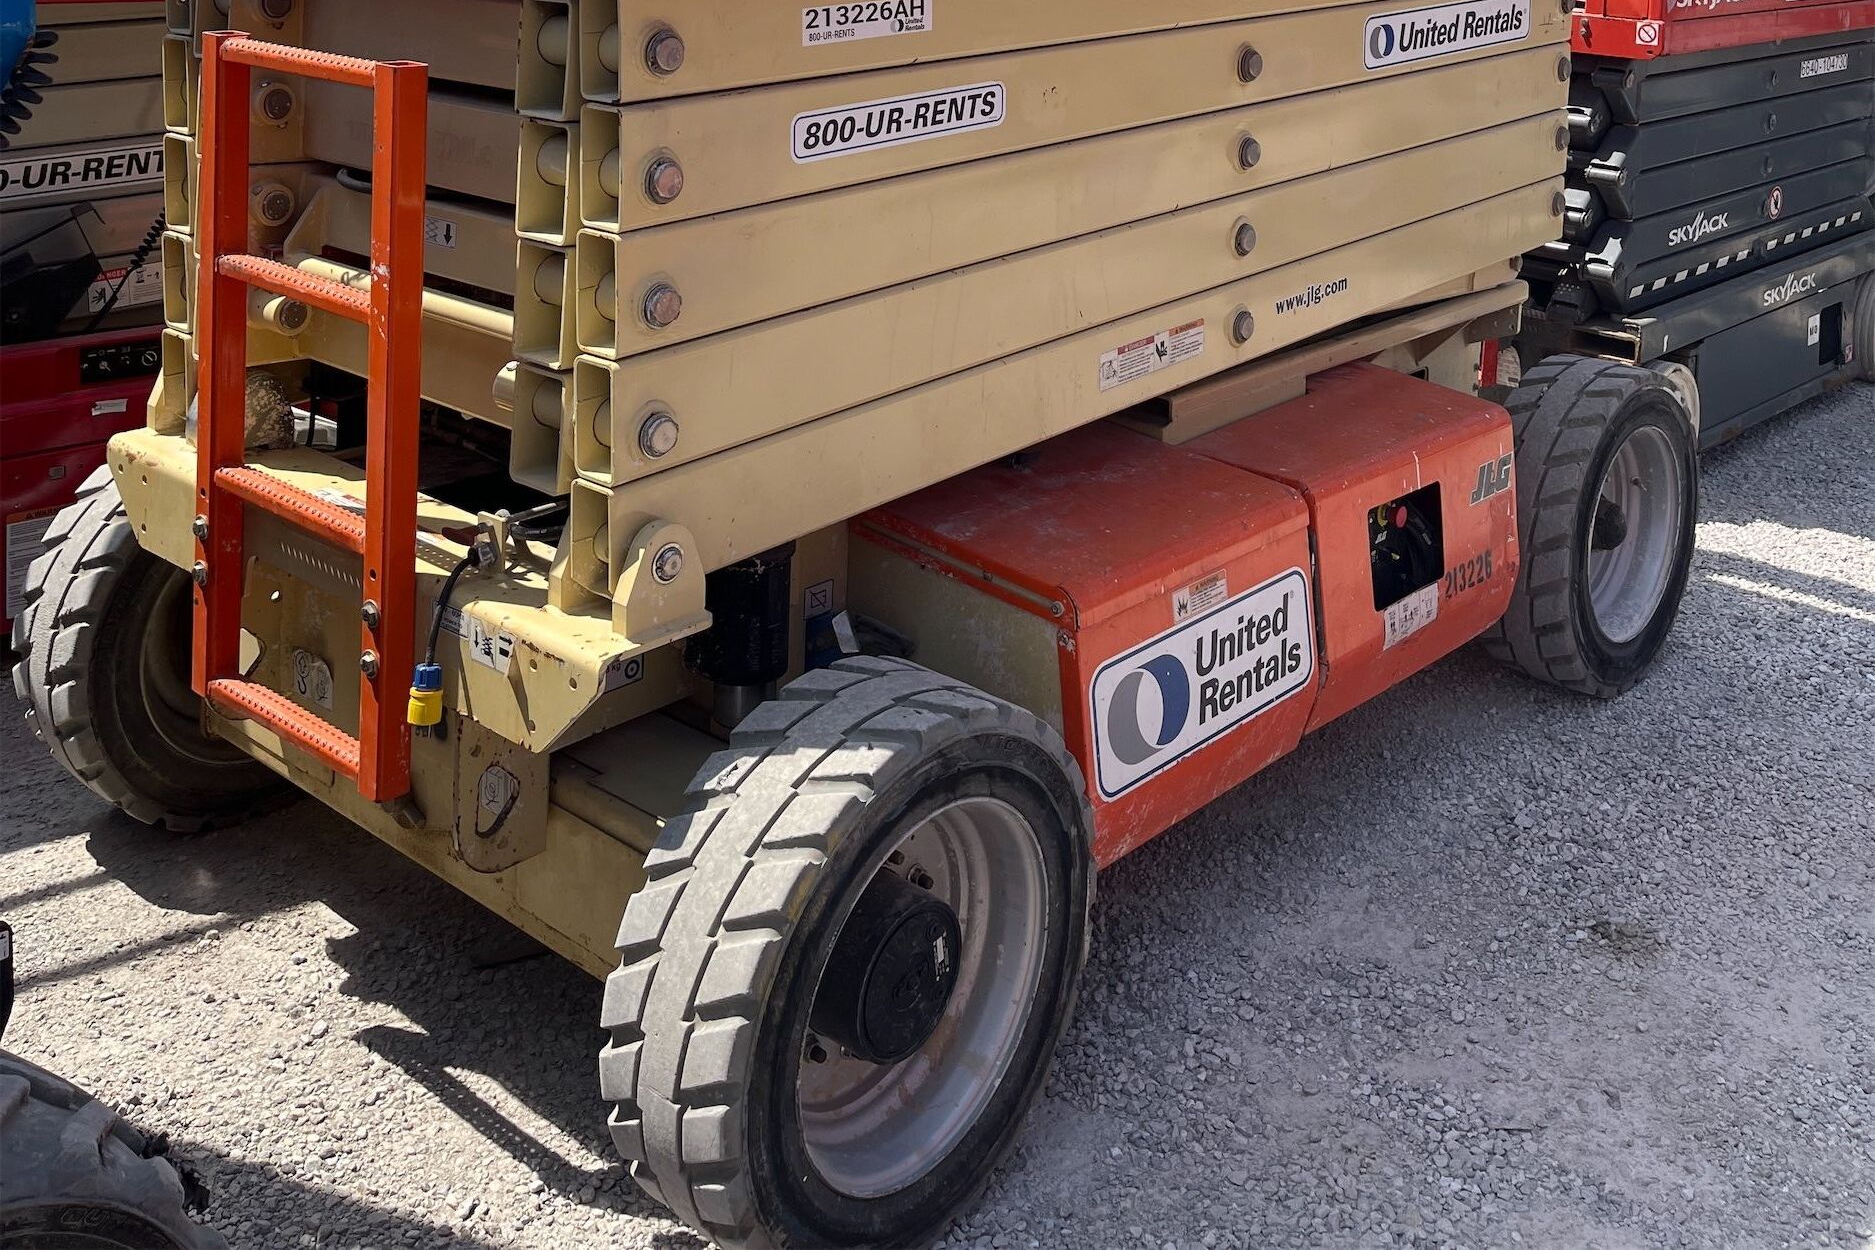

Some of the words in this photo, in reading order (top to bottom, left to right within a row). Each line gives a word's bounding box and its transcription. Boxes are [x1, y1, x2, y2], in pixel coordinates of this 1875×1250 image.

[809, 28, 855, 42] 800-UR-RENTS
[1399, 14, 1460, 52] United
[1463, 4, 1523, 40] Rentals
[803, 91, 996, 150] 800-UR-RENTS
[1668, 211, 1729, 246] SKYJACK
[1276, 278, 1348, 315] www.jlg.com
[1763, 273, 1816, 306] SKYJACK
[1470, 451, 1514, 506] JLG
[1445, 551, 1494, 598] 213226
[1196, 592, 1289, 677] United
[1199, 637, 1301, 726] Rentals
